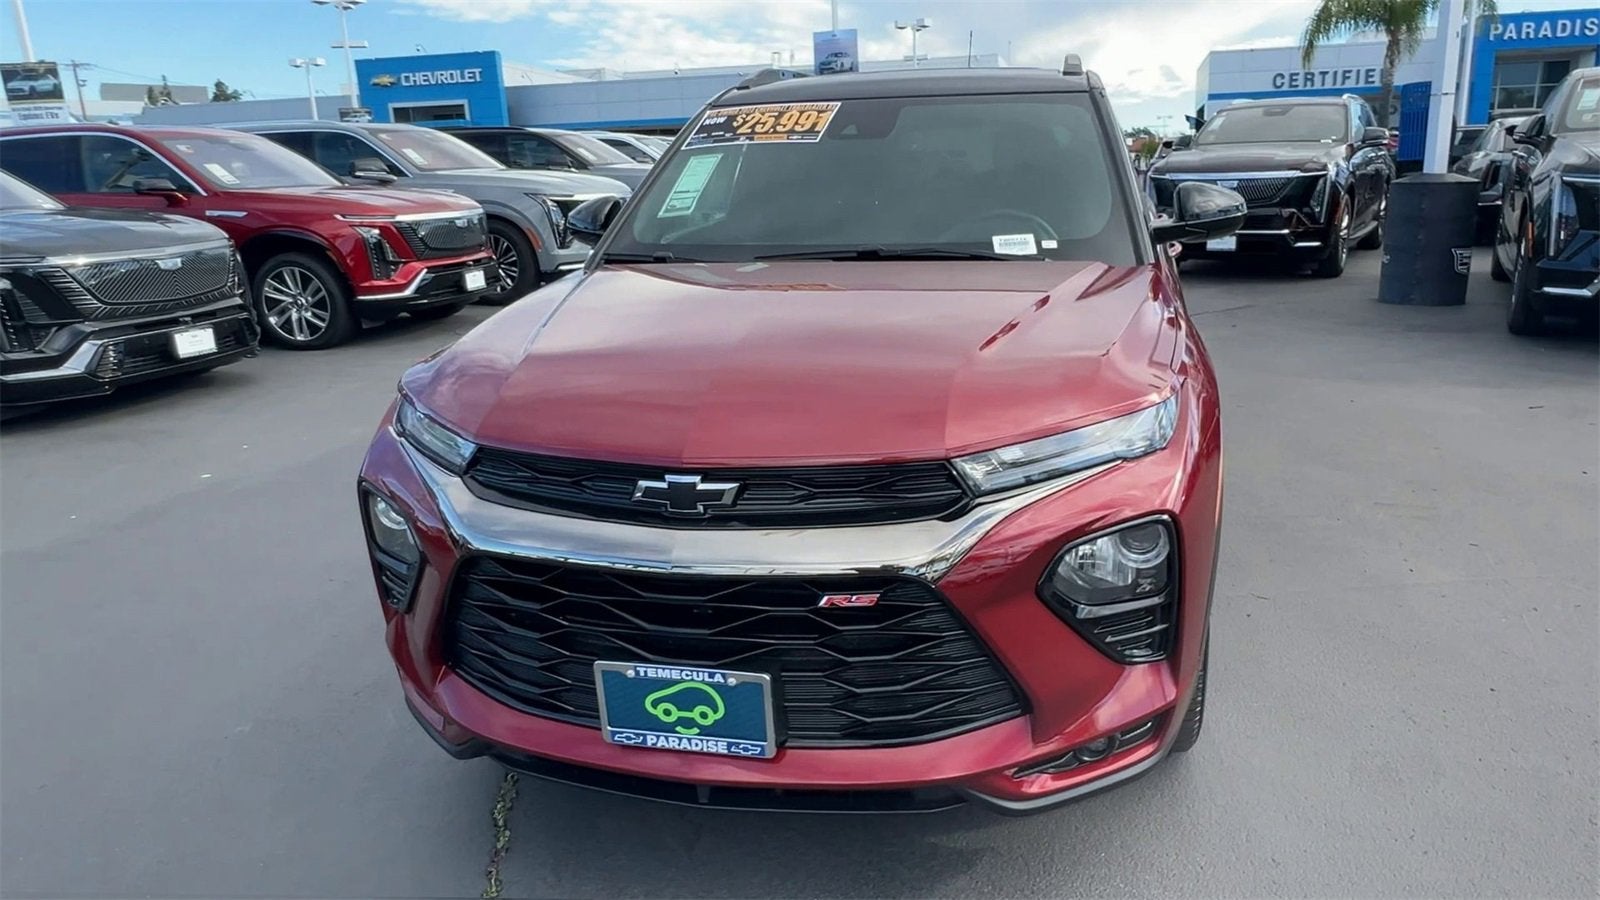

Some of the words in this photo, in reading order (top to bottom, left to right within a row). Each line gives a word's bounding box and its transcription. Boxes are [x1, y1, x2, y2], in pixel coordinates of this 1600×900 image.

[1489, 18, 1599, 41] PARADIS
[401, 68, 482, 86] CHEVROLET
[703, 116, 727, 126] NOW
[732, 110, 833, 134] $25,991
[818, 594, 880, 607] RS
[636, 667, 725, 683] TEMECULA
[646, 735, 728, 753] PARADISE
